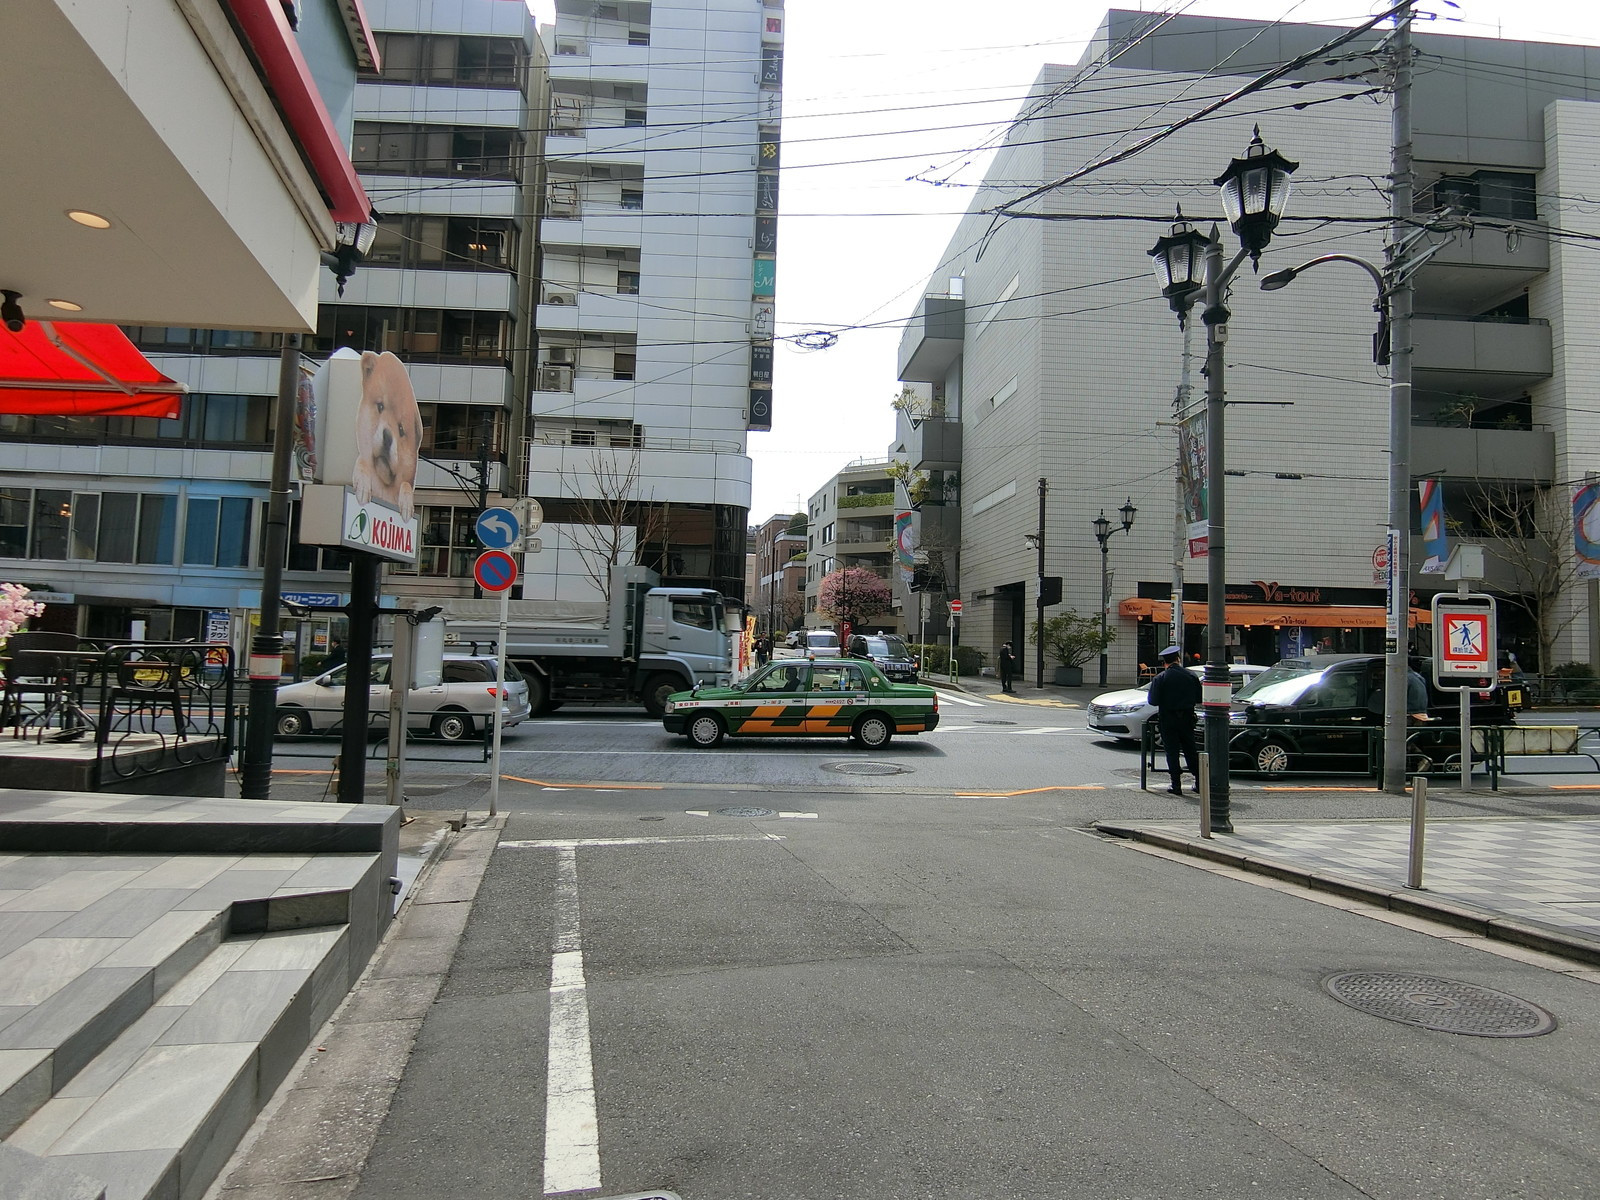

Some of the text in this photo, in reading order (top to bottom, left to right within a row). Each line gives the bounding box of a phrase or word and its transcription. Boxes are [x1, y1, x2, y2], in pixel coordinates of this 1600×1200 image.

[1250, 581, 1320, 602] Va-tout
[843, 623, 850, 631] P
[210, 631, 229, 639] ダウン
